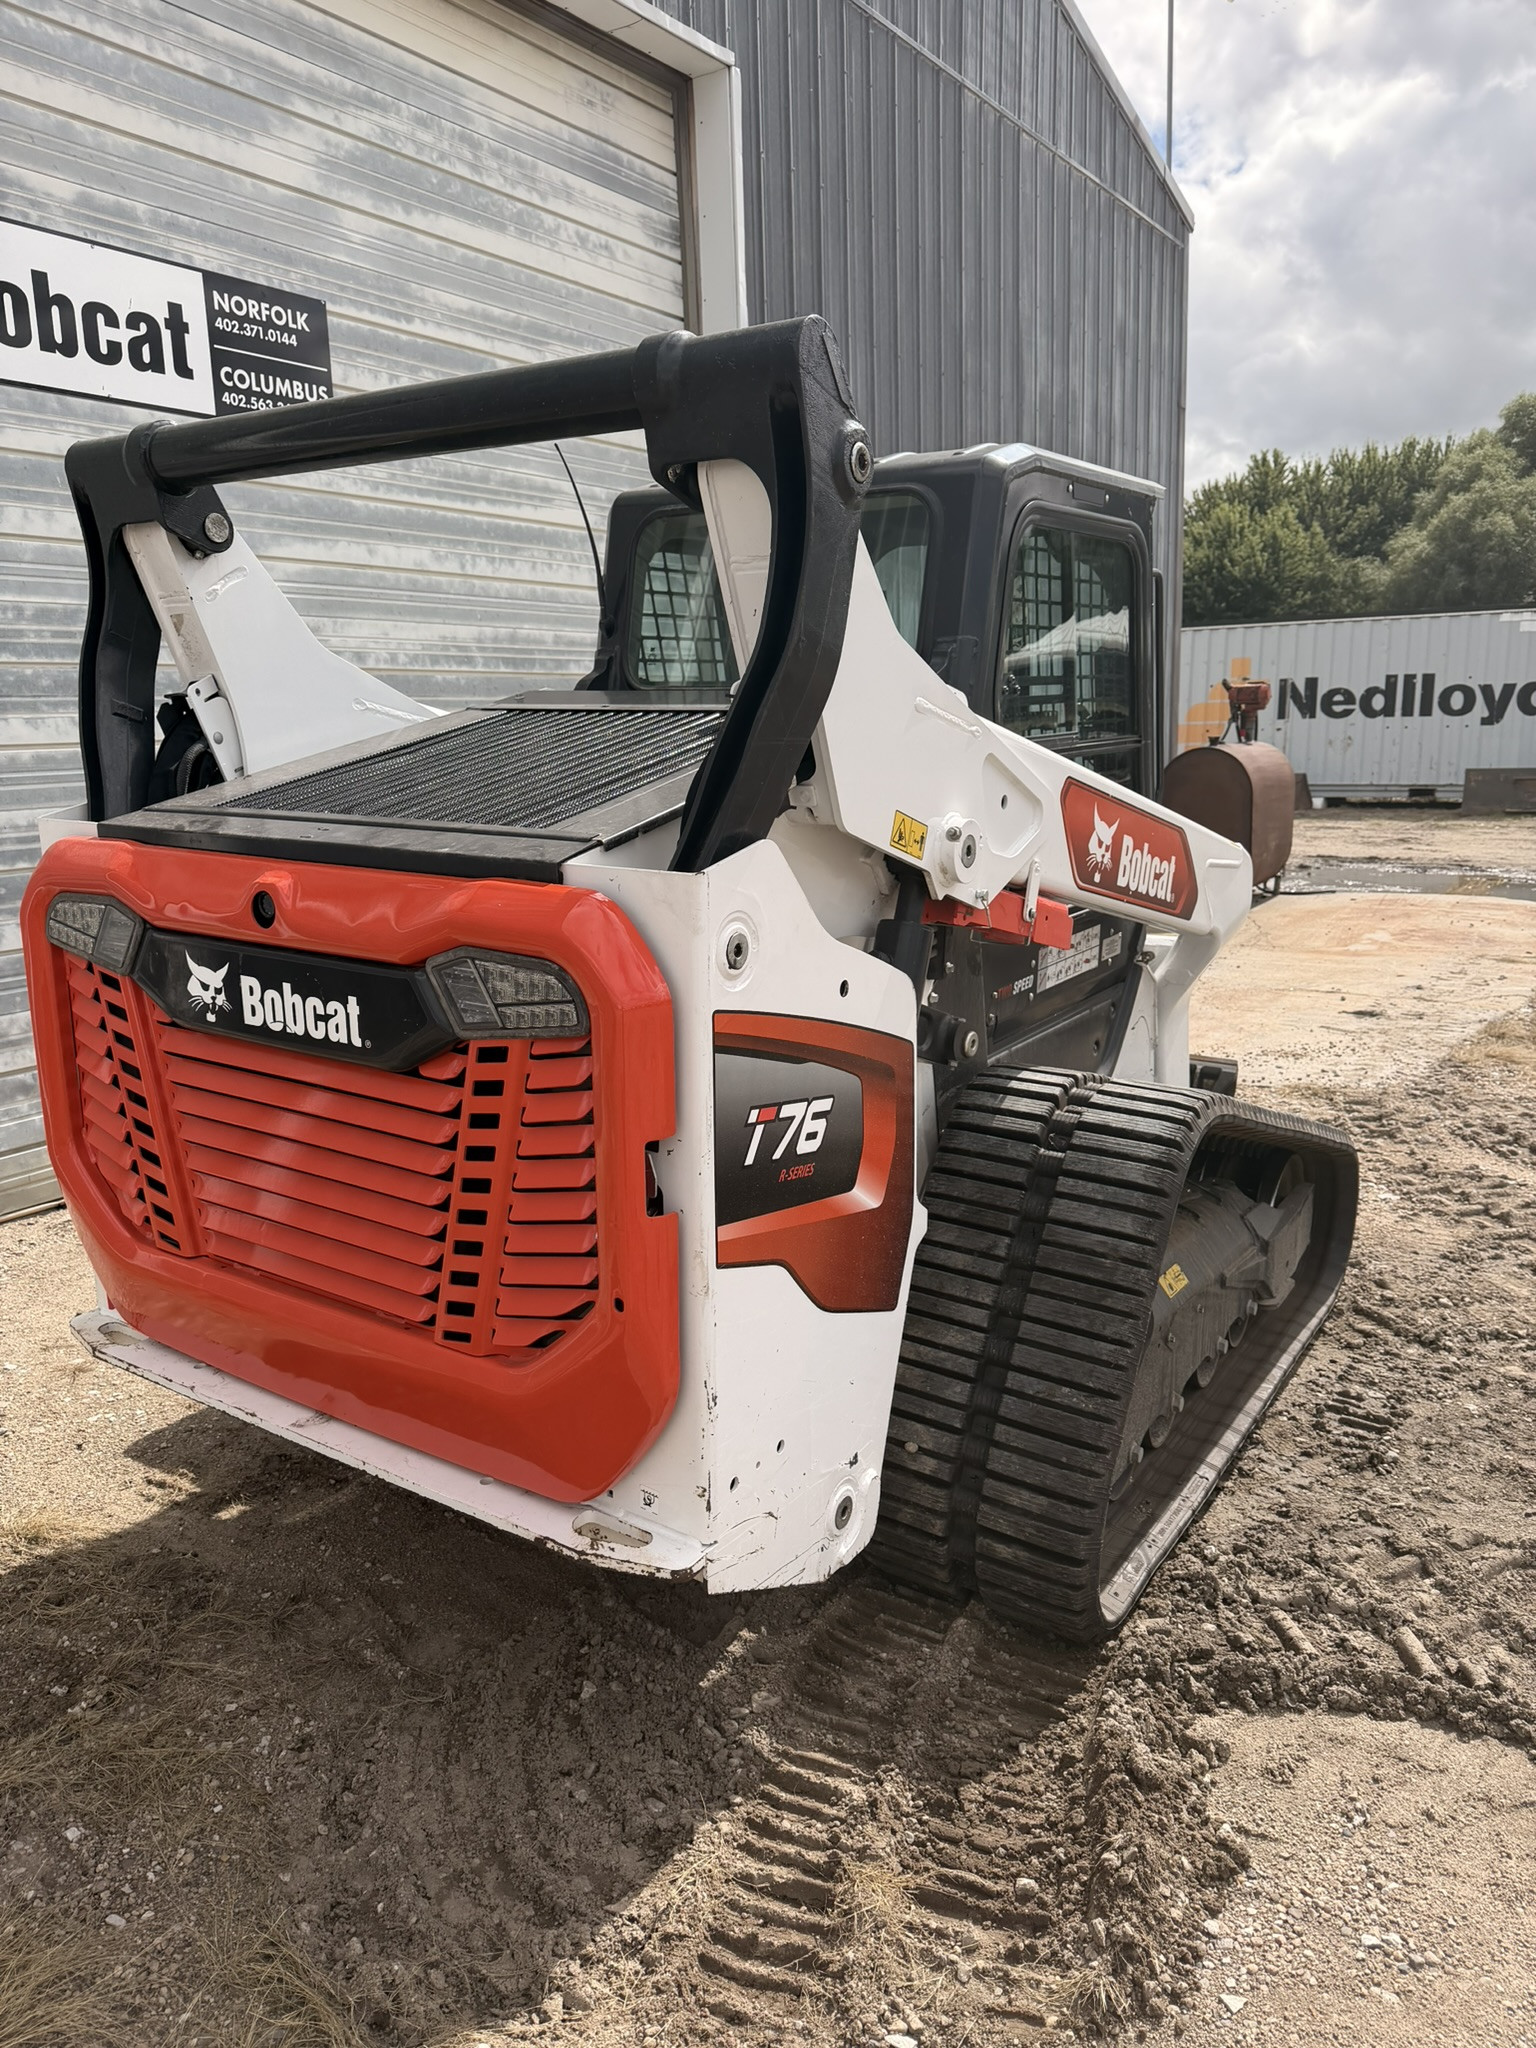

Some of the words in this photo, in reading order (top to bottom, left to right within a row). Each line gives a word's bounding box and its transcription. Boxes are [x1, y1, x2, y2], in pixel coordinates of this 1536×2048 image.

[0, 268, 195, 381] obcat
[212, 289, 311, 333] NORFOLK
[214, 316, 298, 348] 402.371.0144
[220, 365, 329, 403] COLUMBUS
[221, 391, 292, 411] 402.563
[1116, 833, 1176, 903] Bobcat
[1012, 974, 1035, 996] SPEED
[239, 974, 363, 1048] Bobcat
[743, 1096, 834, 1167] T76
[778, 1162, 816, 1183] R-SERIES
